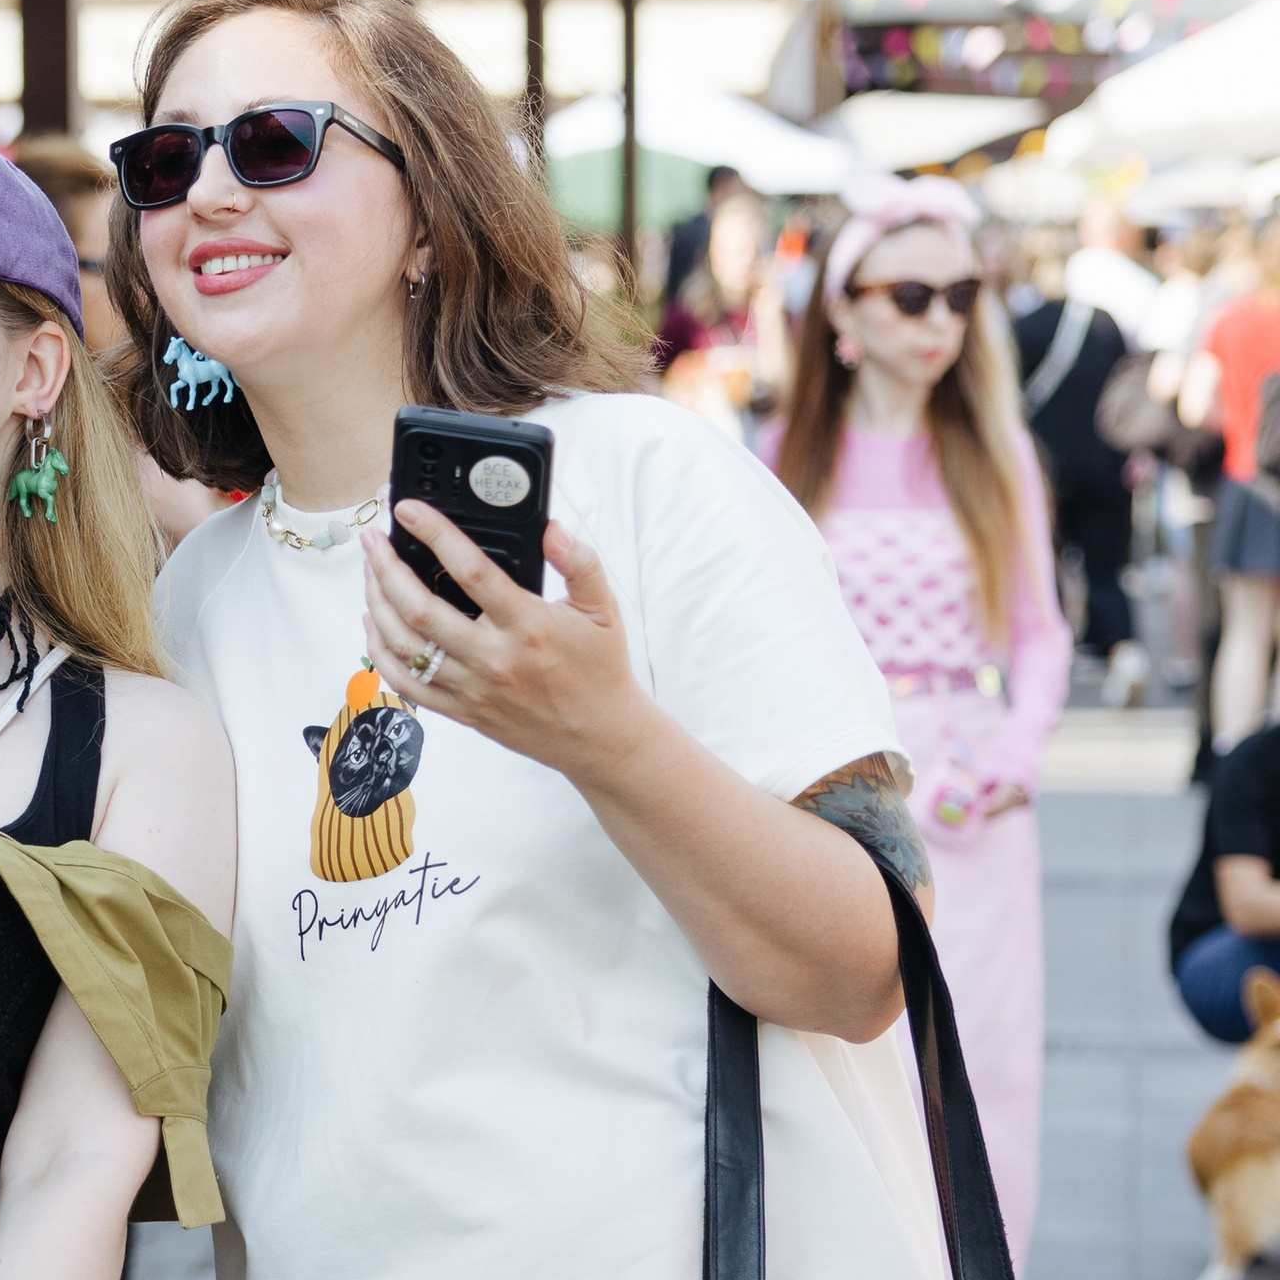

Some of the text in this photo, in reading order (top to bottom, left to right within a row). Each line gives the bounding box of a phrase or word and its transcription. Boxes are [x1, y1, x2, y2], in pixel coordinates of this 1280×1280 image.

[483, 462, 511, 478] ВСЕ
[474, 478, 523, 490] НЕ КАК
[484, 490, 514, 503] ВСЕ
[291, 851, 481, 962] Prinyatie
